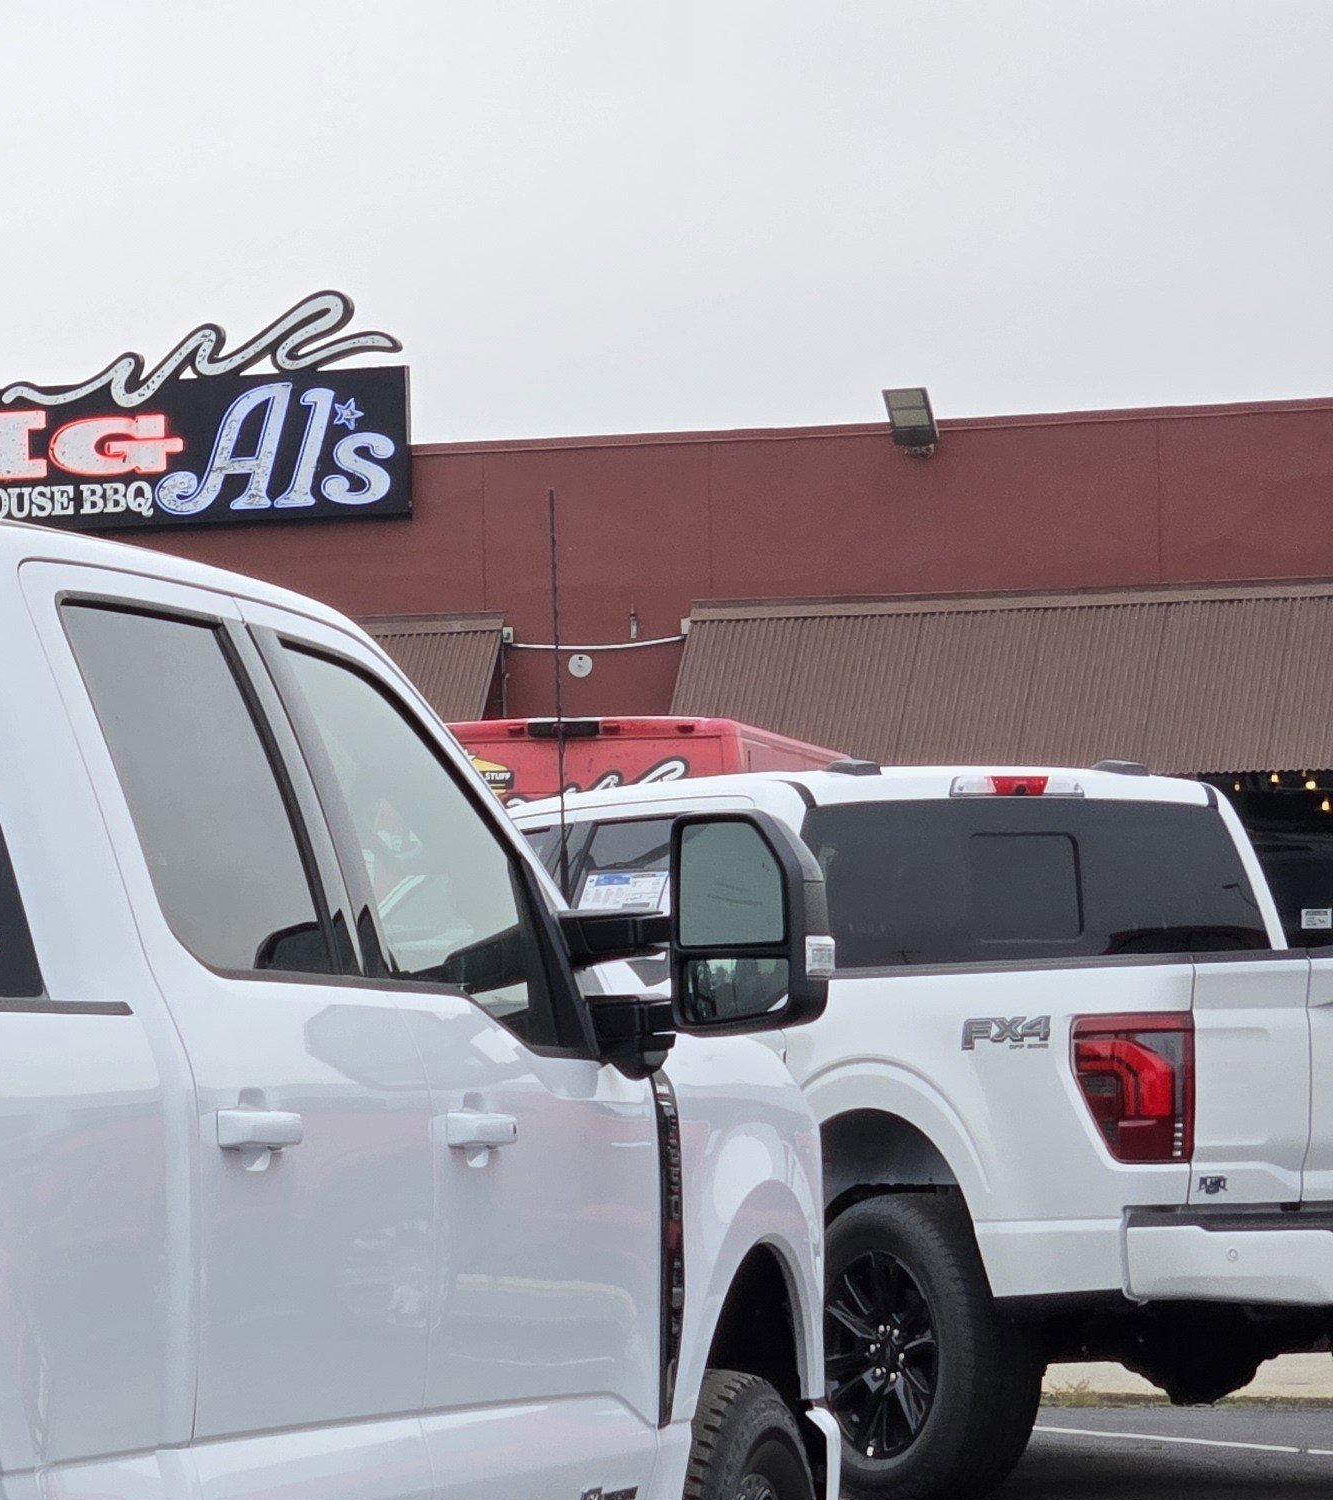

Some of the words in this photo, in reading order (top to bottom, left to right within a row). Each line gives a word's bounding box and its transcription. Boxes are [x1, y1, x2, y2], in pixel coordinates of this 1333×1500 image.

[80, 481, 153, 518] BBQ
[485, 771, 511, 781] STUFF
[961, 1015, 1052, 1051] FX4
